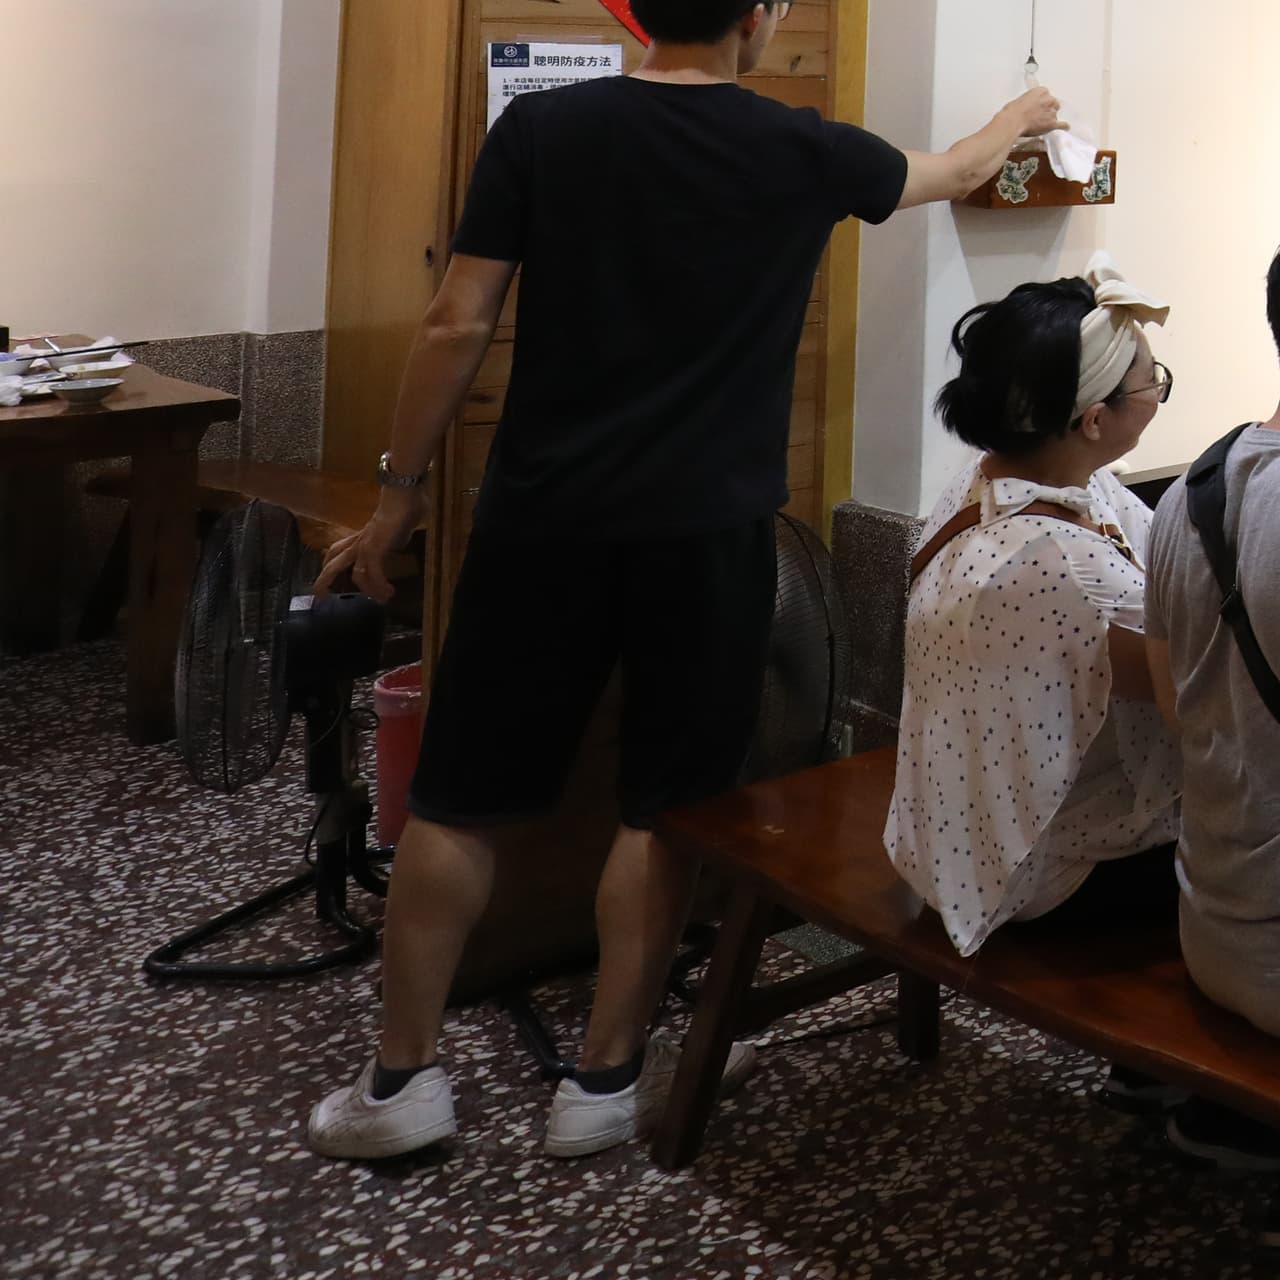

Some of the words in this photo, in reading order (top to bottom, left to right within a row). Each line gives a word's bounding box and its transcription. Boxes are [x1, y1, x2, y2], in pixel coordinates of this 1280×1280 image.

[534, 56, 612, 67] 聰明防疫方法
